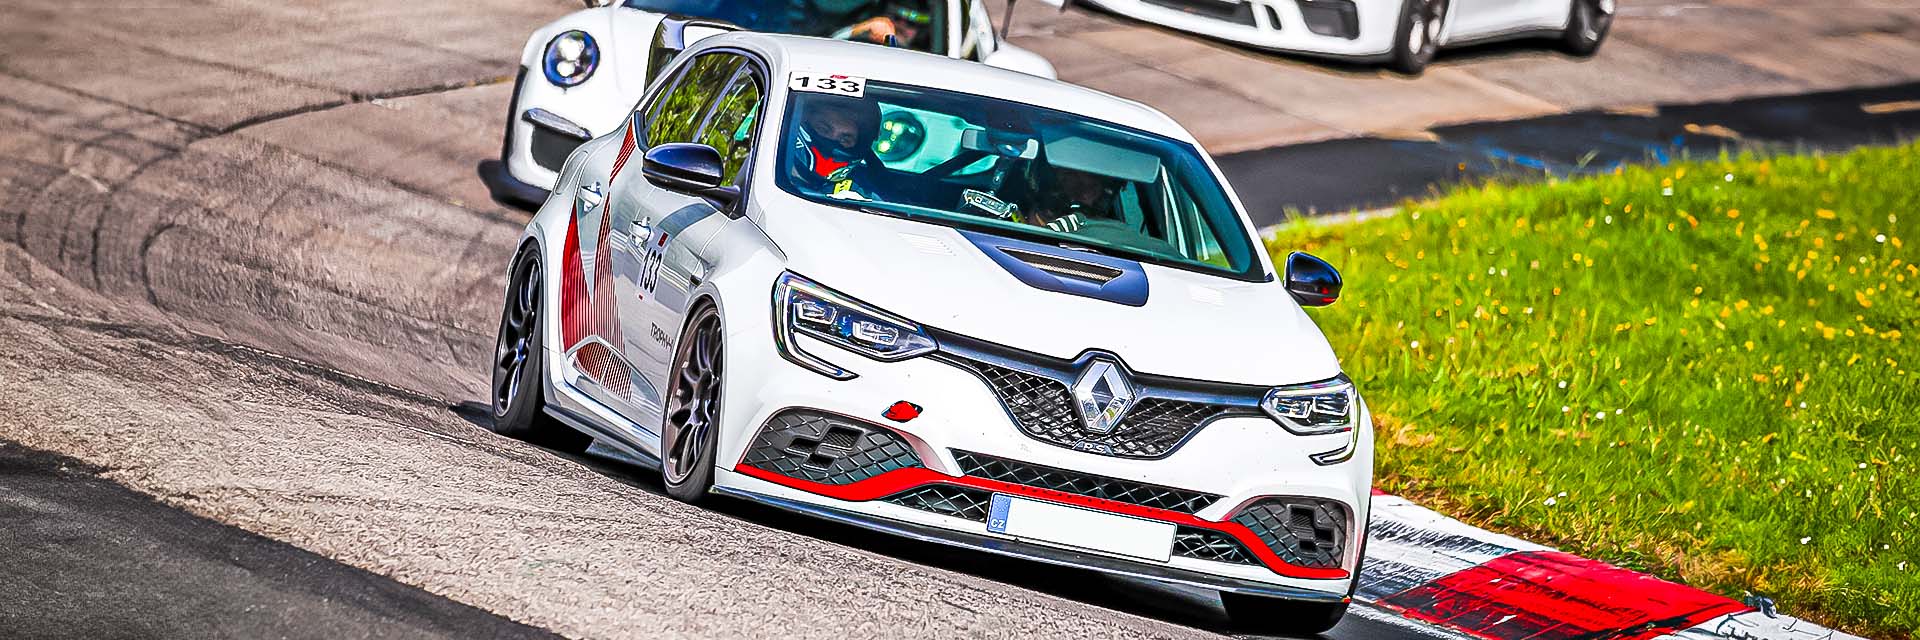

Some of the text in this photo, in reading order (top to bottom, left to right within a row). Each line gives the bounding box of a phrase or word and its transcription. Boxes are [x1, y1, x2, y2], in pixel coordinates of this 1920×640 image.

[795, 76, 860, 93] 133
[640, 247, 662, 293] 133
[990, 518, 1005, 529] CZ
